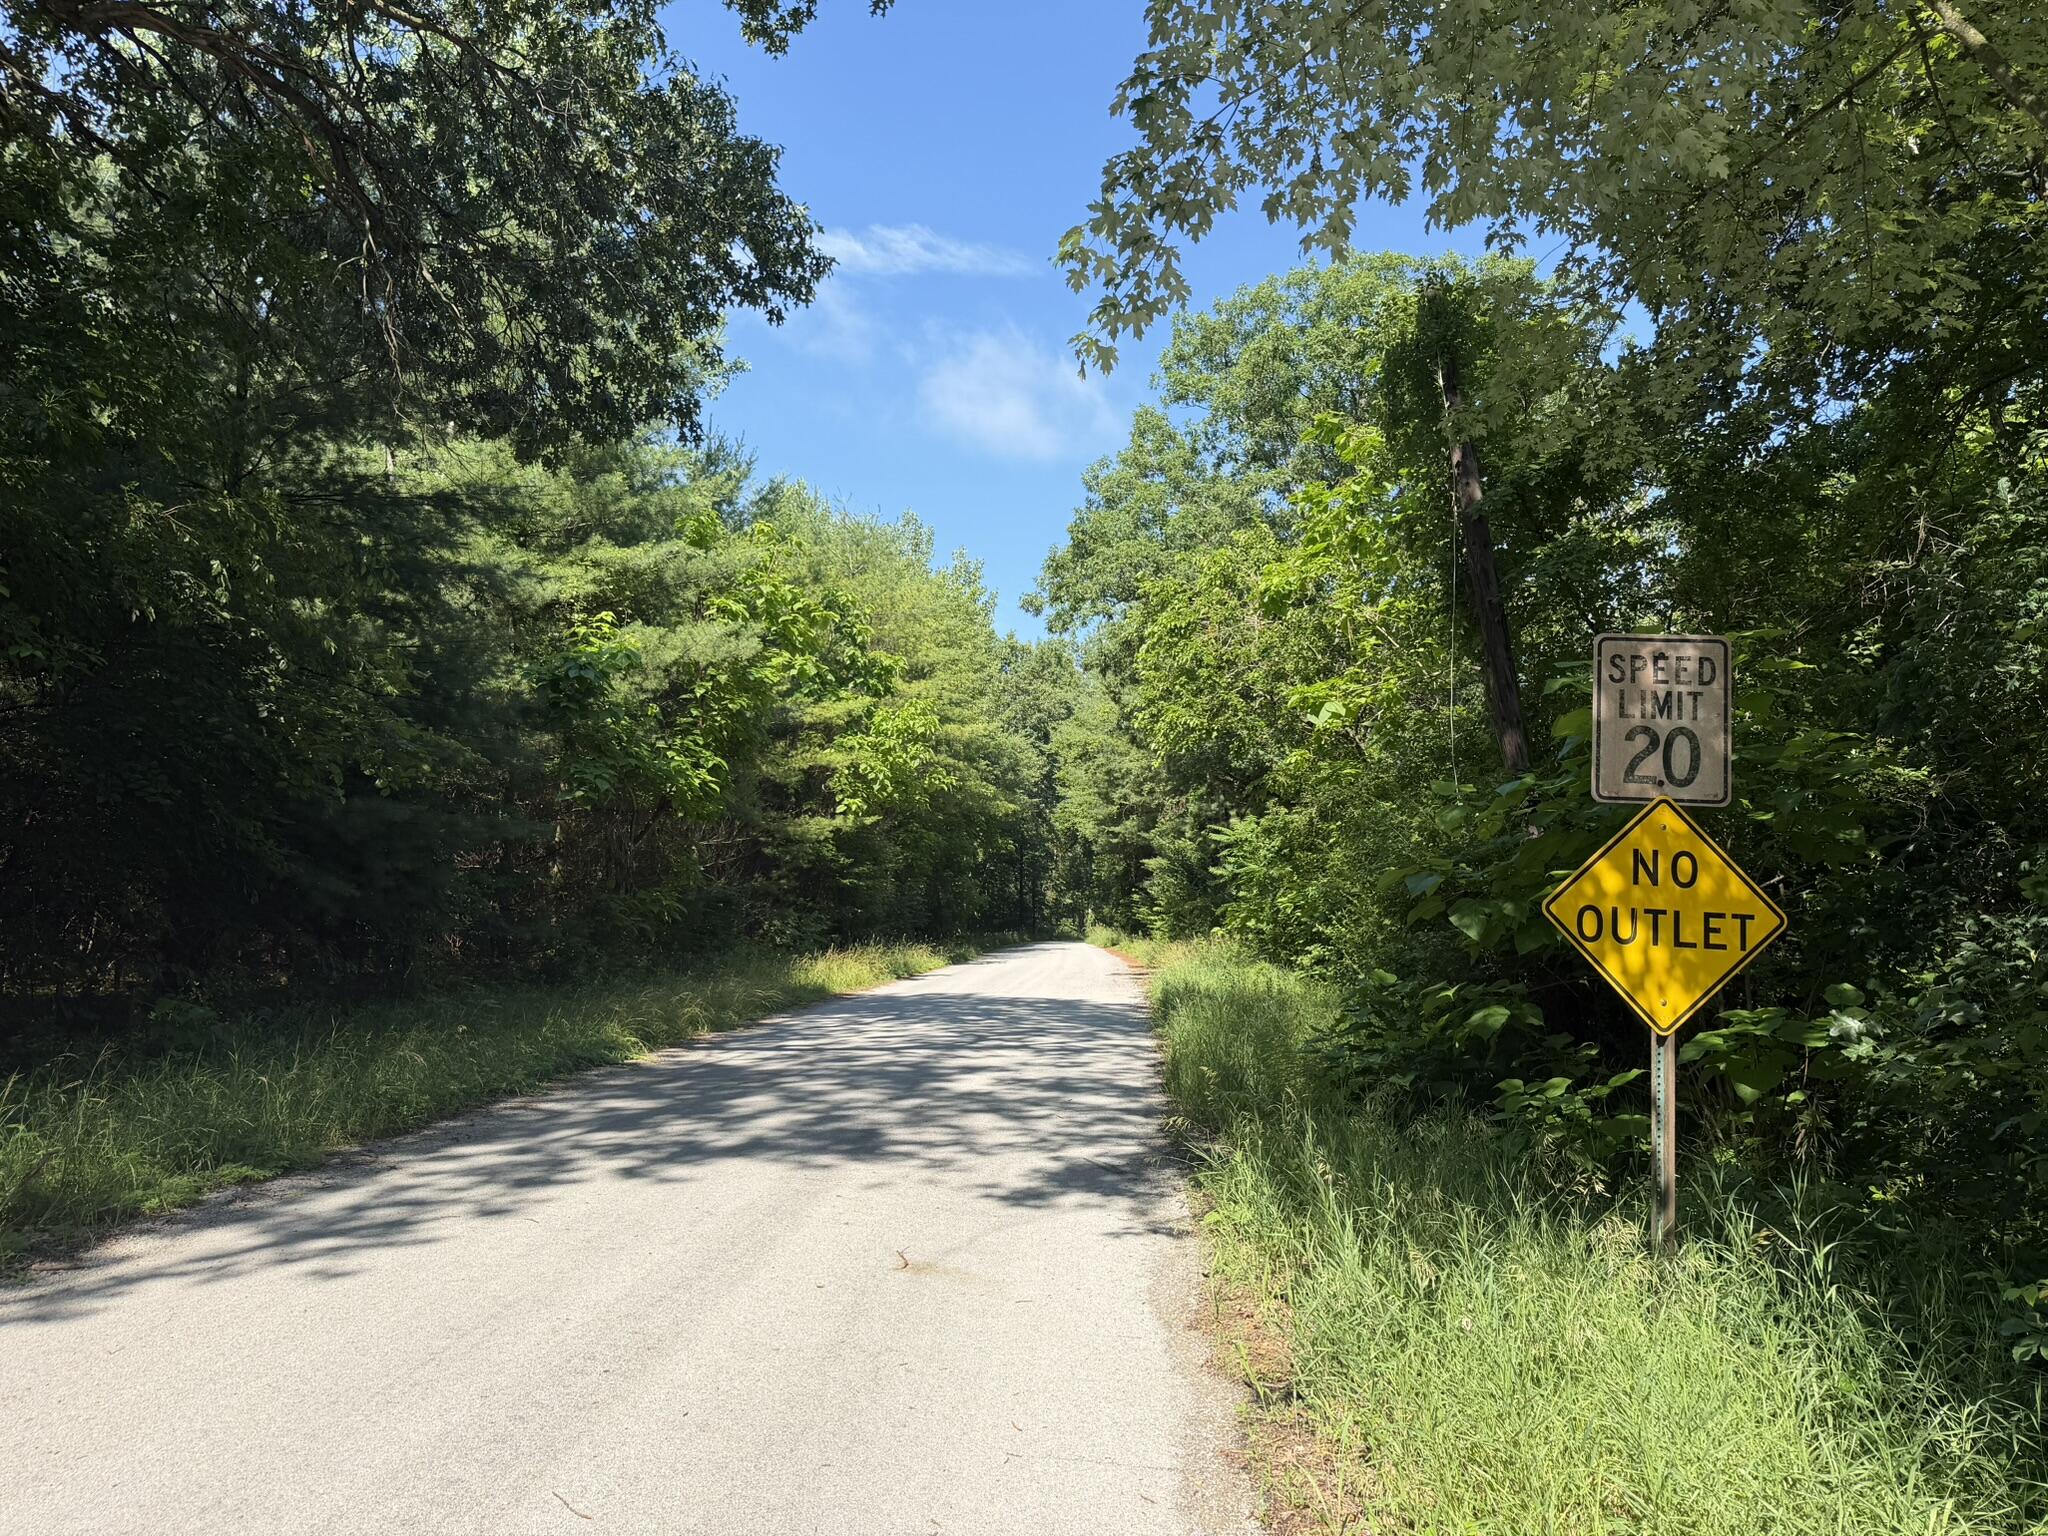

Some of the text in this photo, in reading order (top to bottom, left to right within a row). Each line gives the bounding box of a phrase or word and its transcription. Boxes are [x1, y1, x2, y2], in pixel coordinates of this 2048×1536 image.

[1608, 654, 1716, 685] SPEED
[1618, 690, 1704, 720] LIMIT
[1623, 726, 1701, 788] 20
[1632, 849, 1699, 888] NO
[1577, 905, 1755, 951] OUTLET
